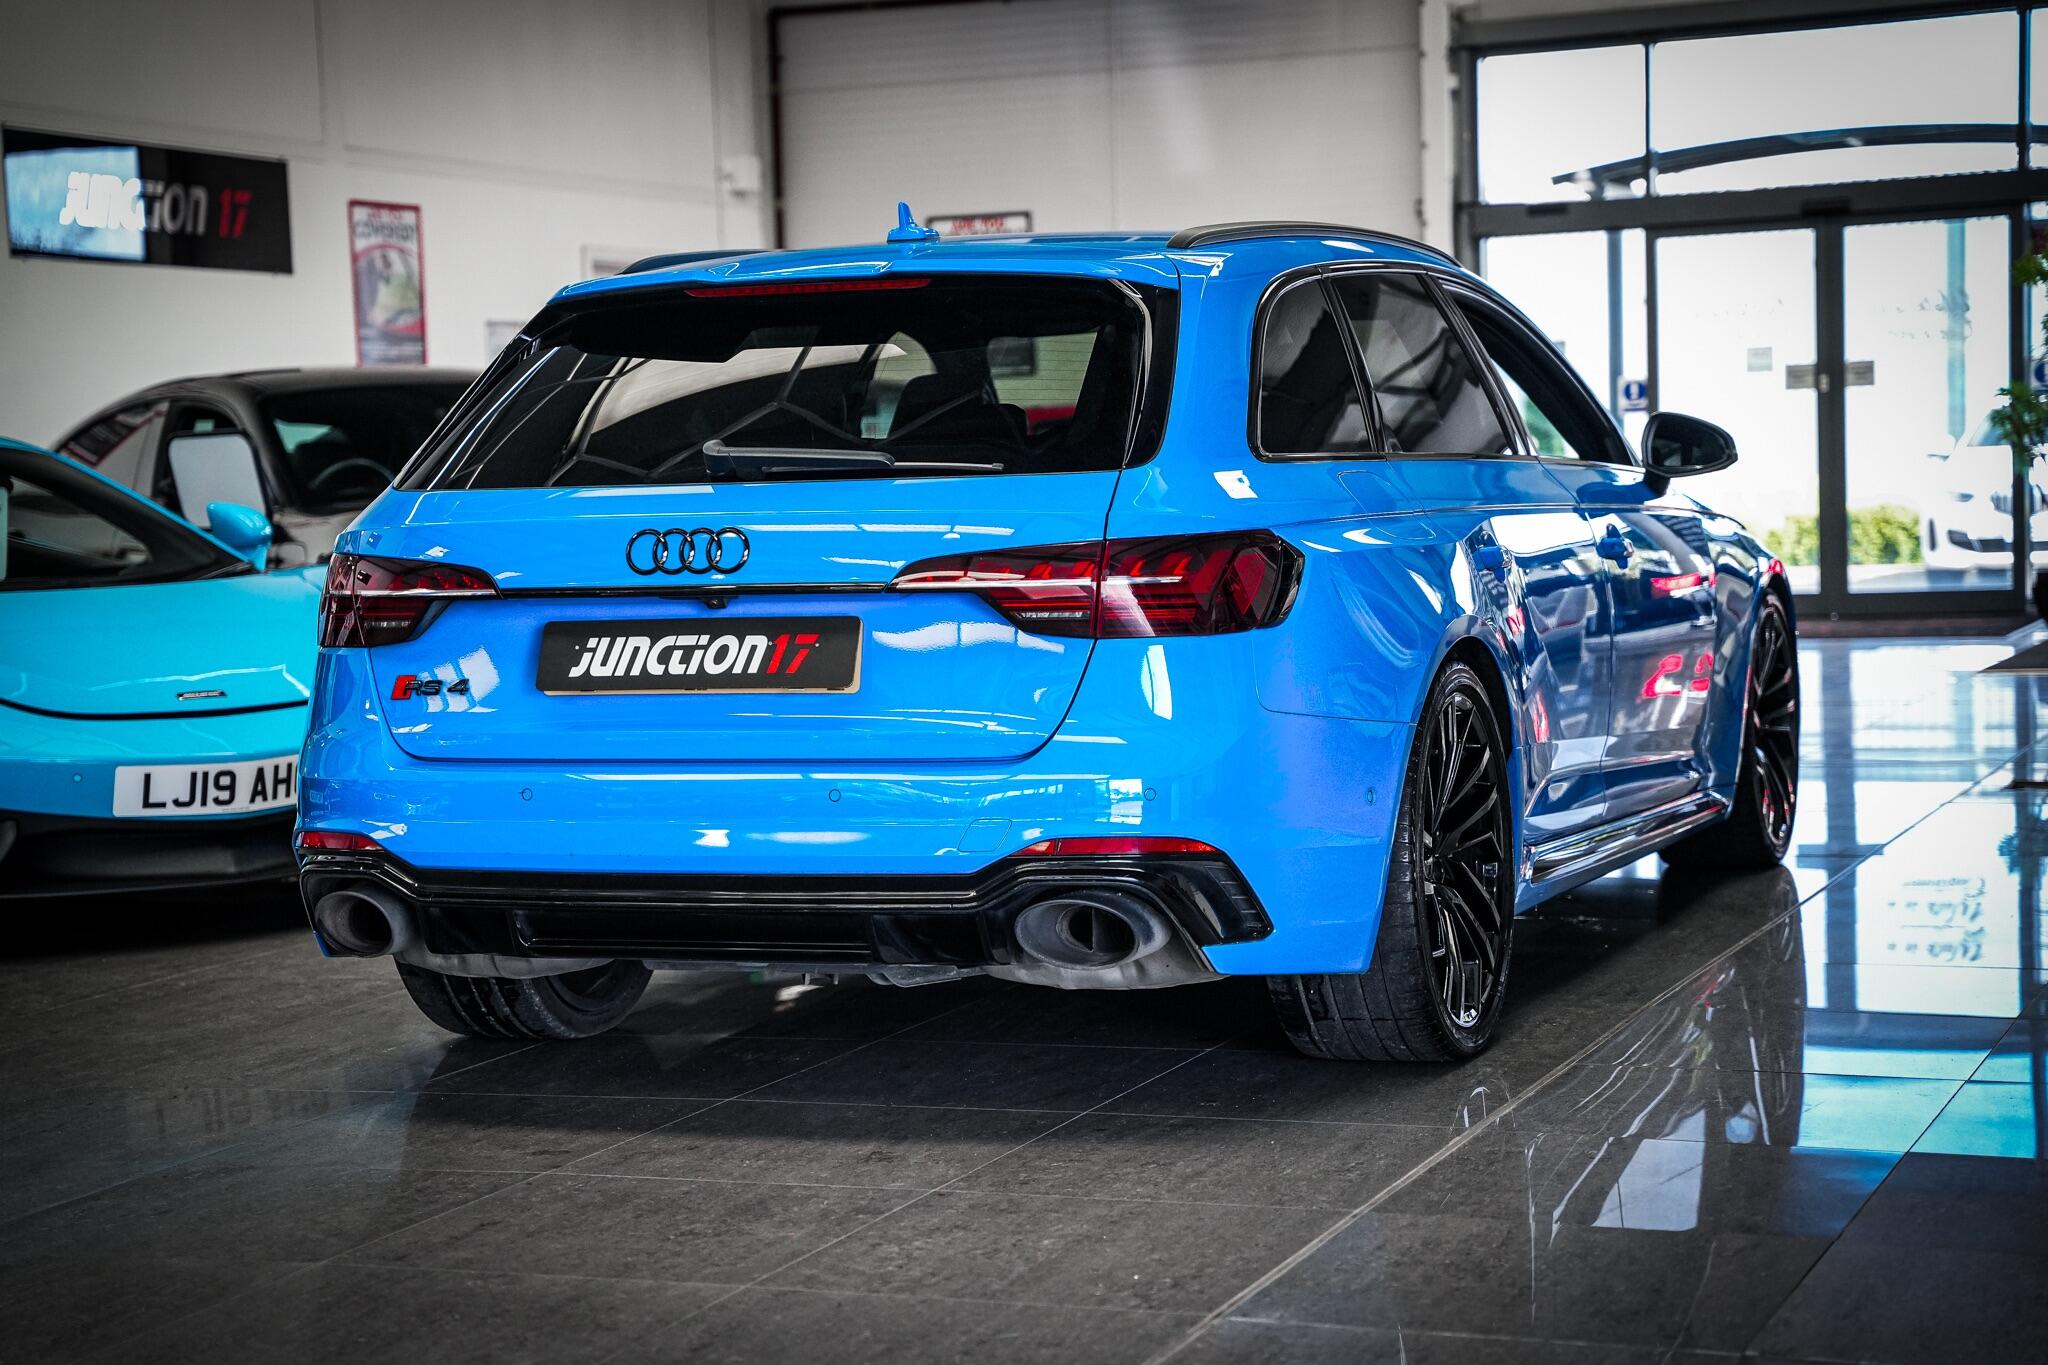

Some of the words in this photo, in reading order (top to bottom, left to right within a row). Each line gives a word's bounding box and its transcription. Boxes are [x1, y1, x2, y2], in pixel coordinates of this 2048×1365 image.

[59, 171, 208, 236] JUNCTION
[218, 188, 253, 240] 17
[402, 679, 443, 697] RS
[446, 679, 470, 696] 4
[141, 770, 237, 809] LJ19
[249, 762, 298, 804] AH
